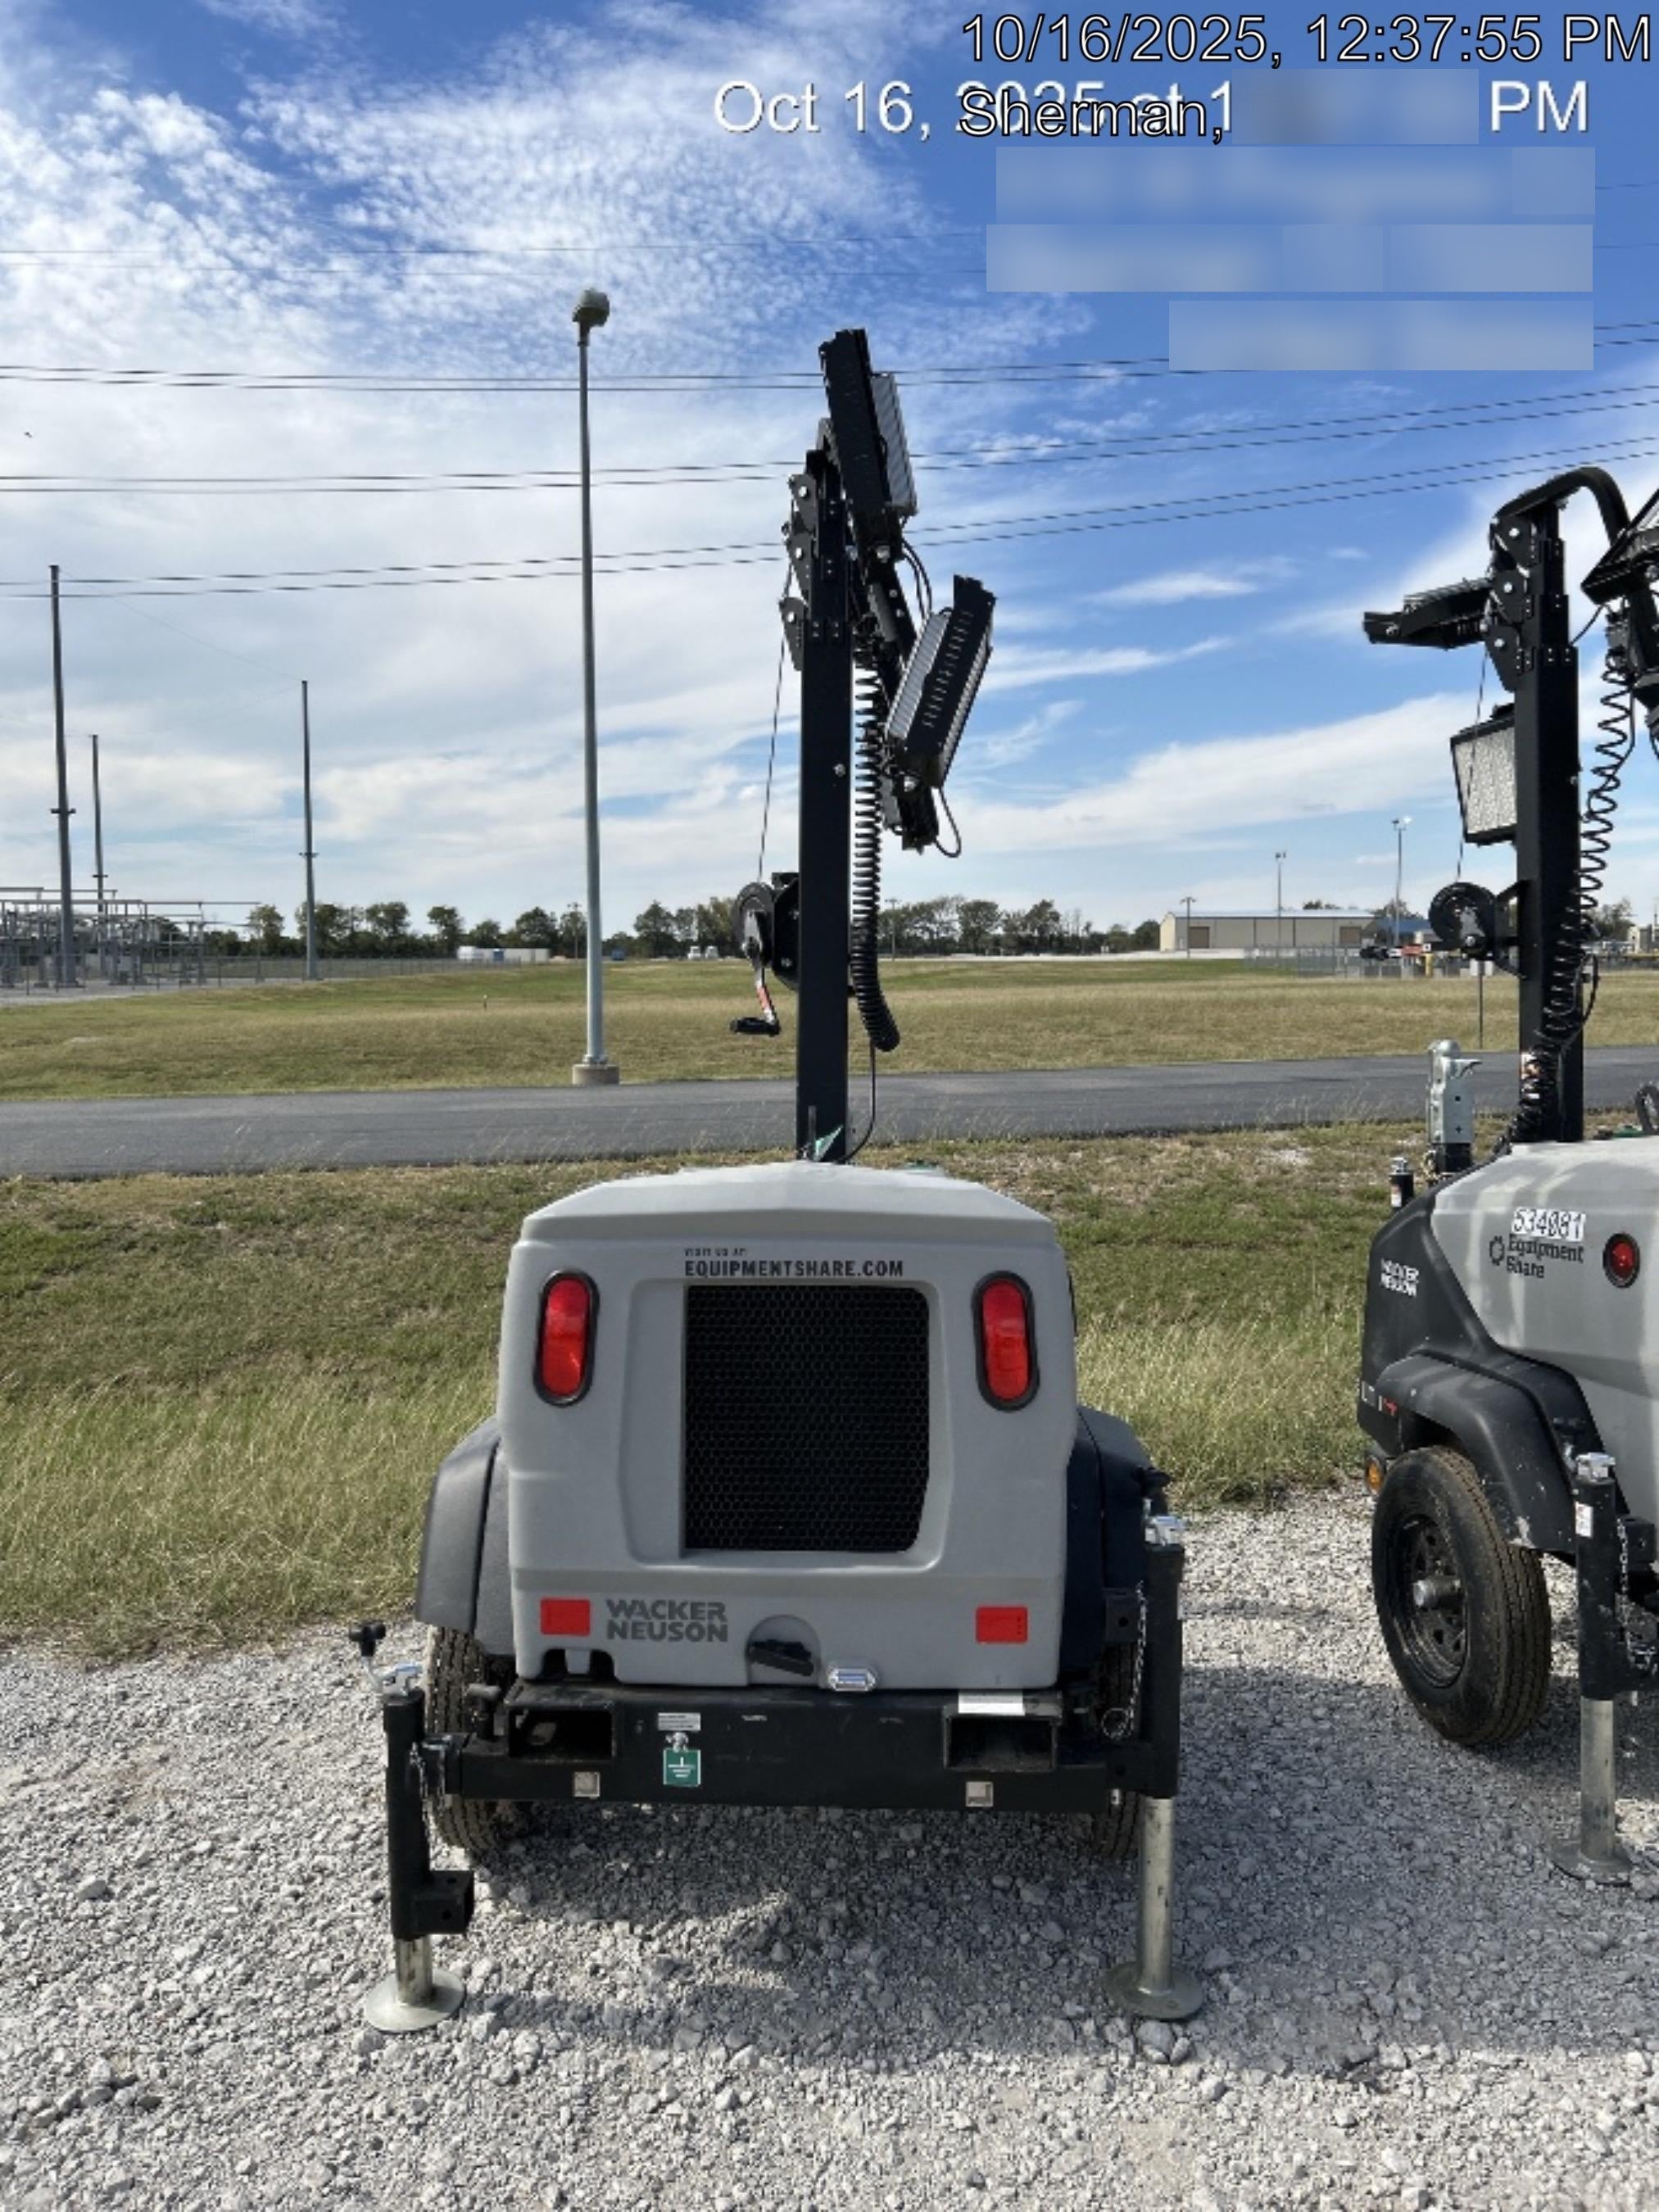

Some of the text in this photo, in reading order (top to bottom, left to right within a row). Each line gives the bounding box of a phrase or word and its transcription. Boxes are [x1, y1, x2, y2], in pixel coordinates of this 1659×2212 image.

[1508, 1233, 1584, 1264] Equipment
[684, 1260, 904, 1278] EQUIPMENTSHARE.COM
[605, 1599, 728, 1622] WACKER
[607, 1619, 728, 1642] NEUSON
